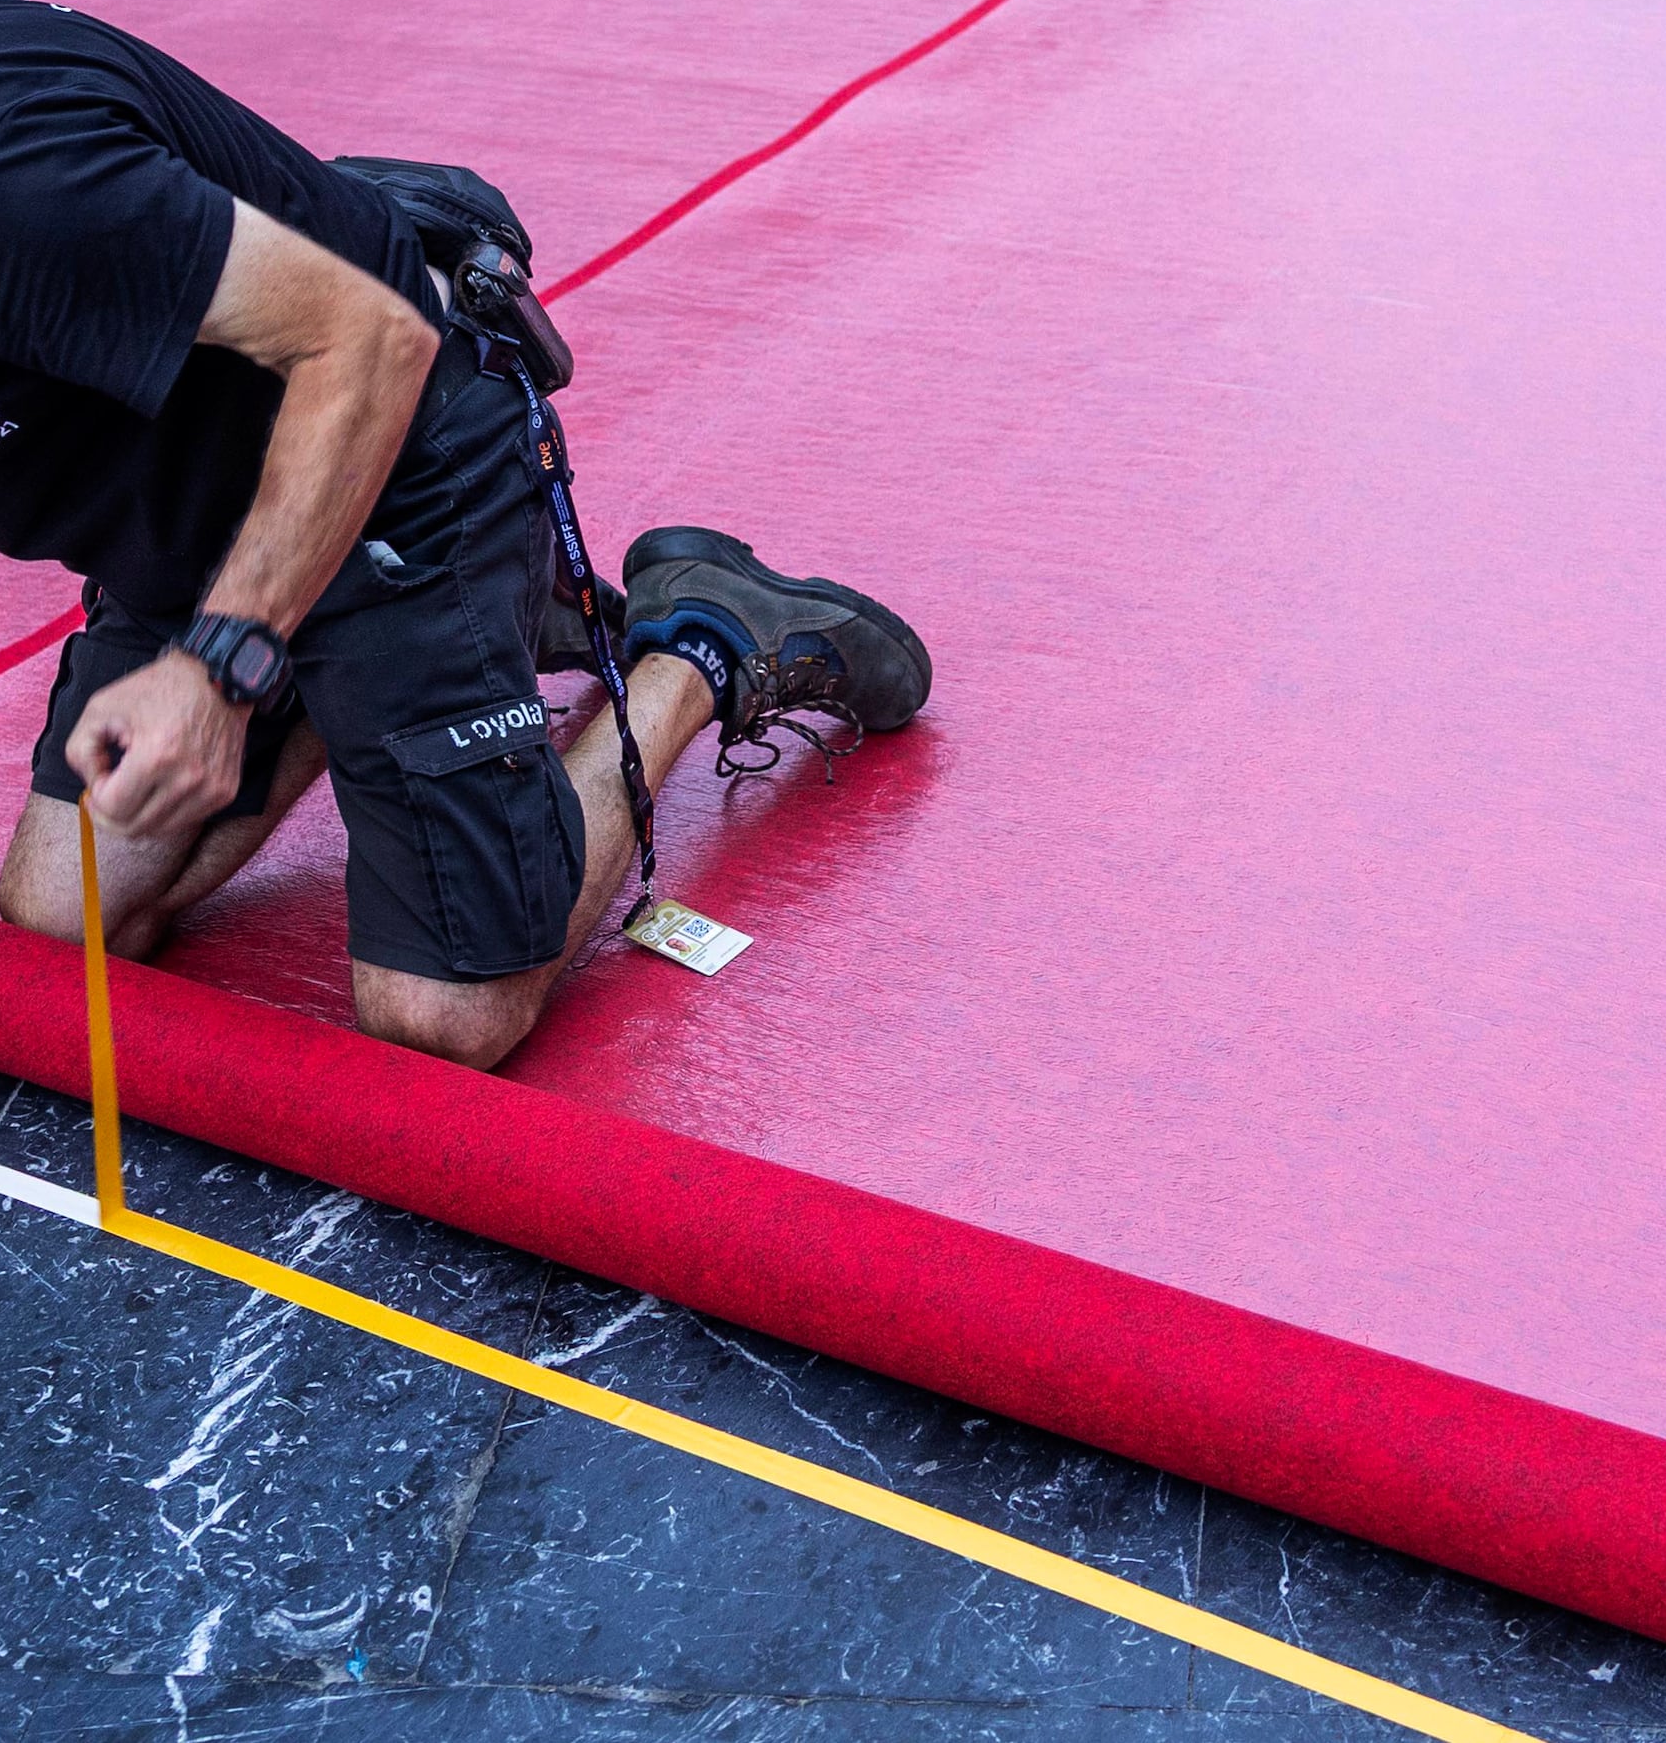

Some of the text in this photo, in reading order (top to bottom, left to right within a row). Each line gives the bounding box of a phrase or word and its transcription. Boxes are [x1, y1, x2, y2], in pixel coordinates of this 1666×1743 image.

[538, 440, 555, 472] rtve
[561, 523, 581, 561] SSIFF
[447, 702, 545, 749] Loyola
